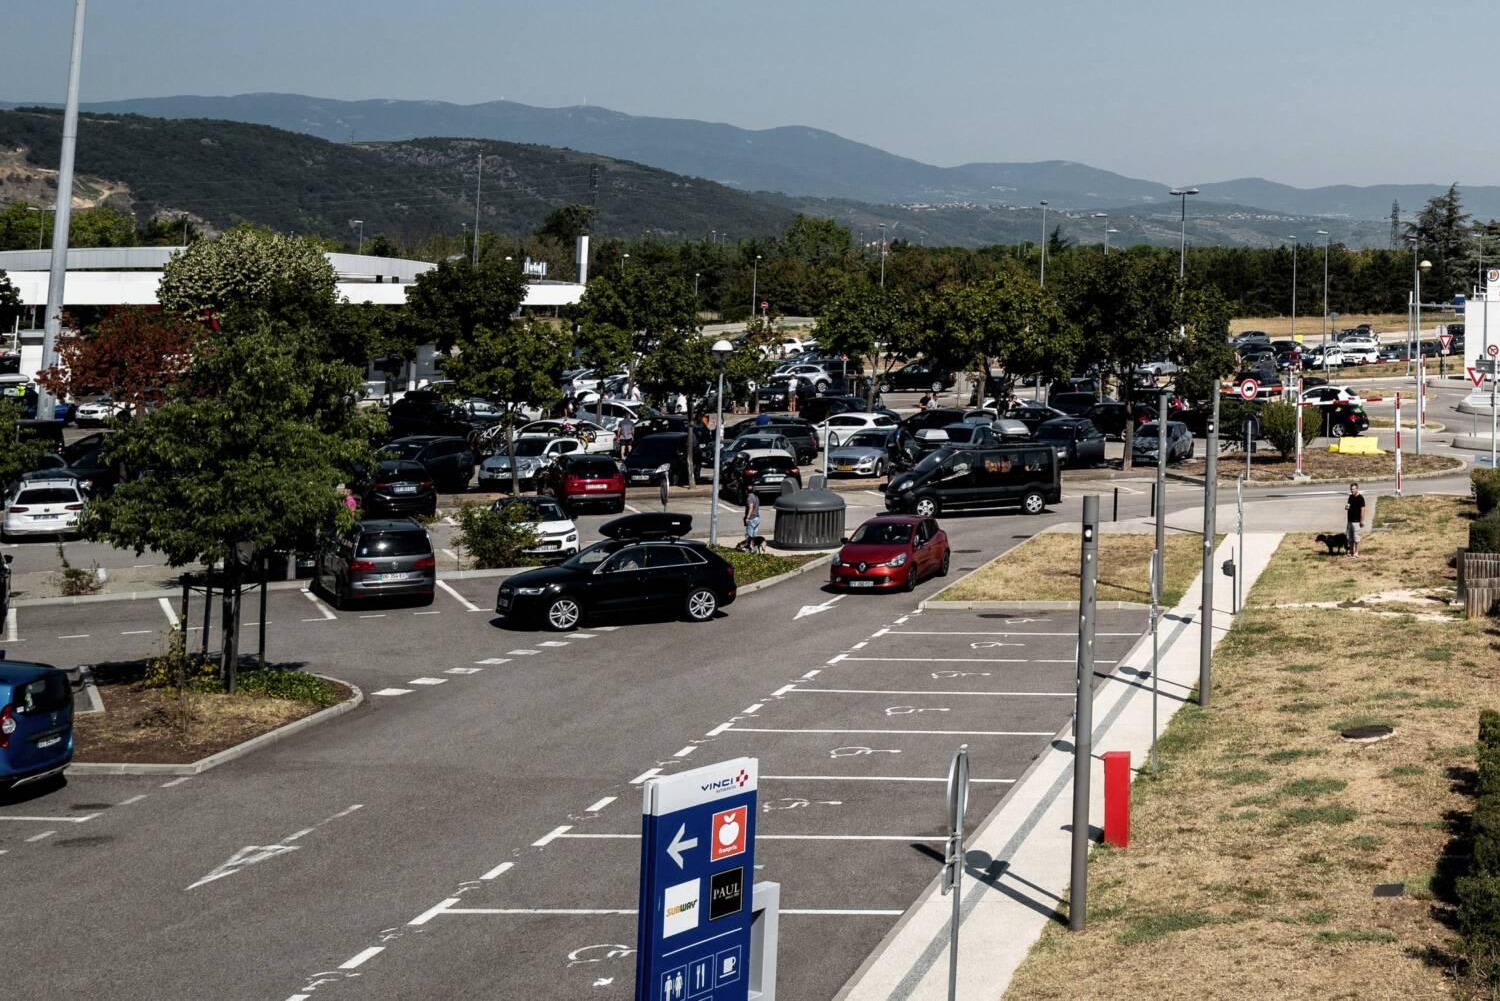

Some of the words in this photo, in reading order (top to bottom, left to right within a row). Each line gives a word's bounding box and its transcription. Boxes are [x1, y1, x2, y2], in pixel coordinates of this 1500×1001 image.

[701, 778, 734, 791] VINCI
[713, 882, 740, 900] PAUL
[666, 899, 698, 917] SUBWAY
